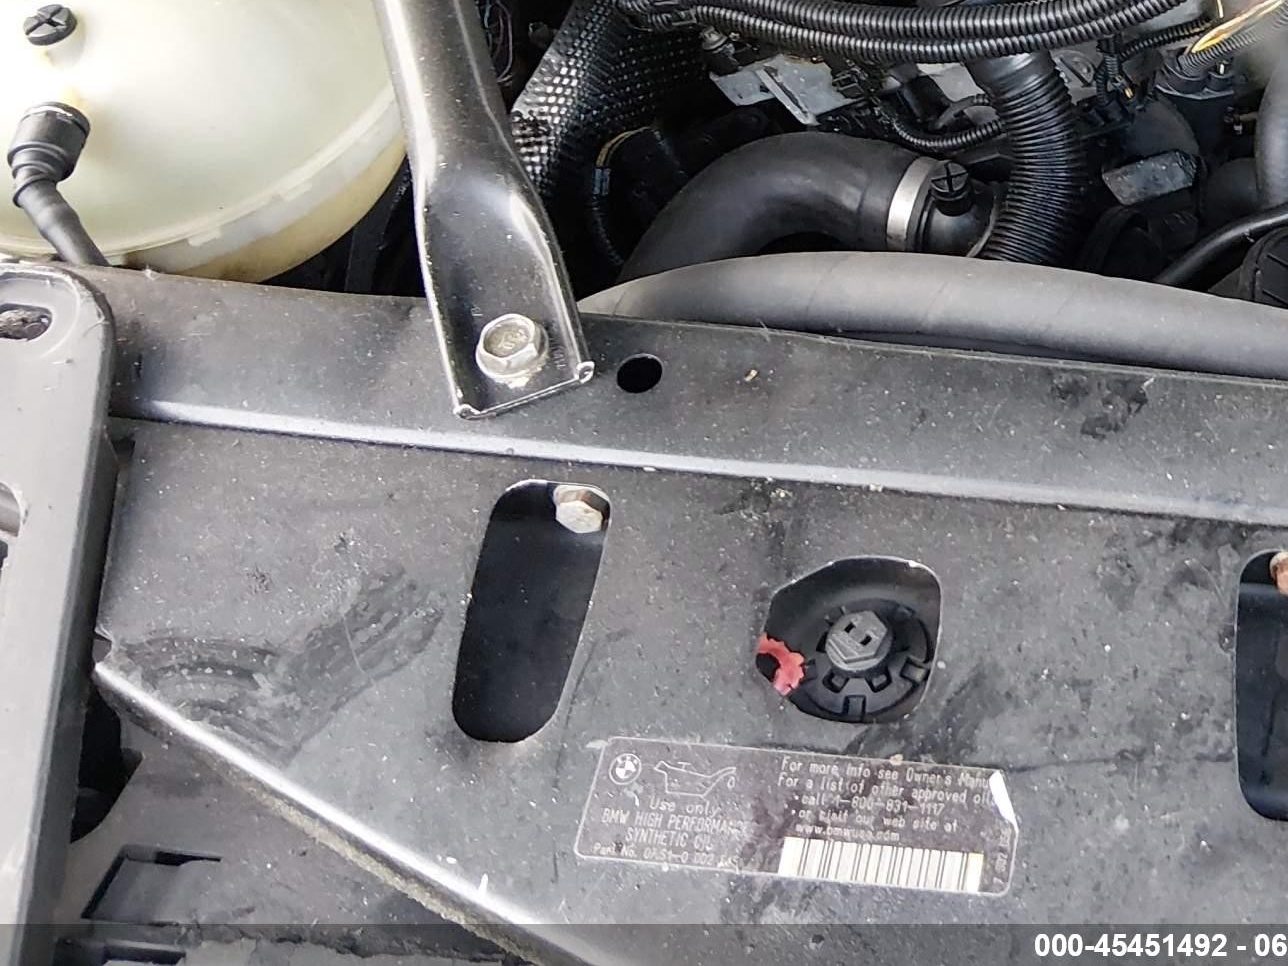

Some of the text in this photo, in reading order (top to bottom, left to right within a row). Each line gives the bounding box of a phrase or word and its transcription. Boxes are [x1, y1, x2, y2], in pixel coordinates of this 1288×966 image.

[781, 755, 803, 773] For
[809, 762, 839, 776] more
[846, 762, 871, 778] info
[878, 769, 899, 781] see
[906, 767, 953, 786] Owner's
[778, 772, 800, 787] For
[806, 778, 814, 789] a
[820, 776, 844, 794] list
[850, 779, 865, 794] of
[871, 780, 904, 797] other
[911, 789, 968, 804] approved
[802, 793, 825, 806] call
[602, 808, 630, 825] BMW
[634, 811, 664, 829] HIGH
[650, 796, 720, 819] Use only
[799, 810, 812, 821] or
[856, 814, 875, 825] our
[883, 816, 906, 828] web
[912, 818, 938, 831] site
[944, 819, 959, 833] at
[625, 827, 689, 848] SYNTHETIC
